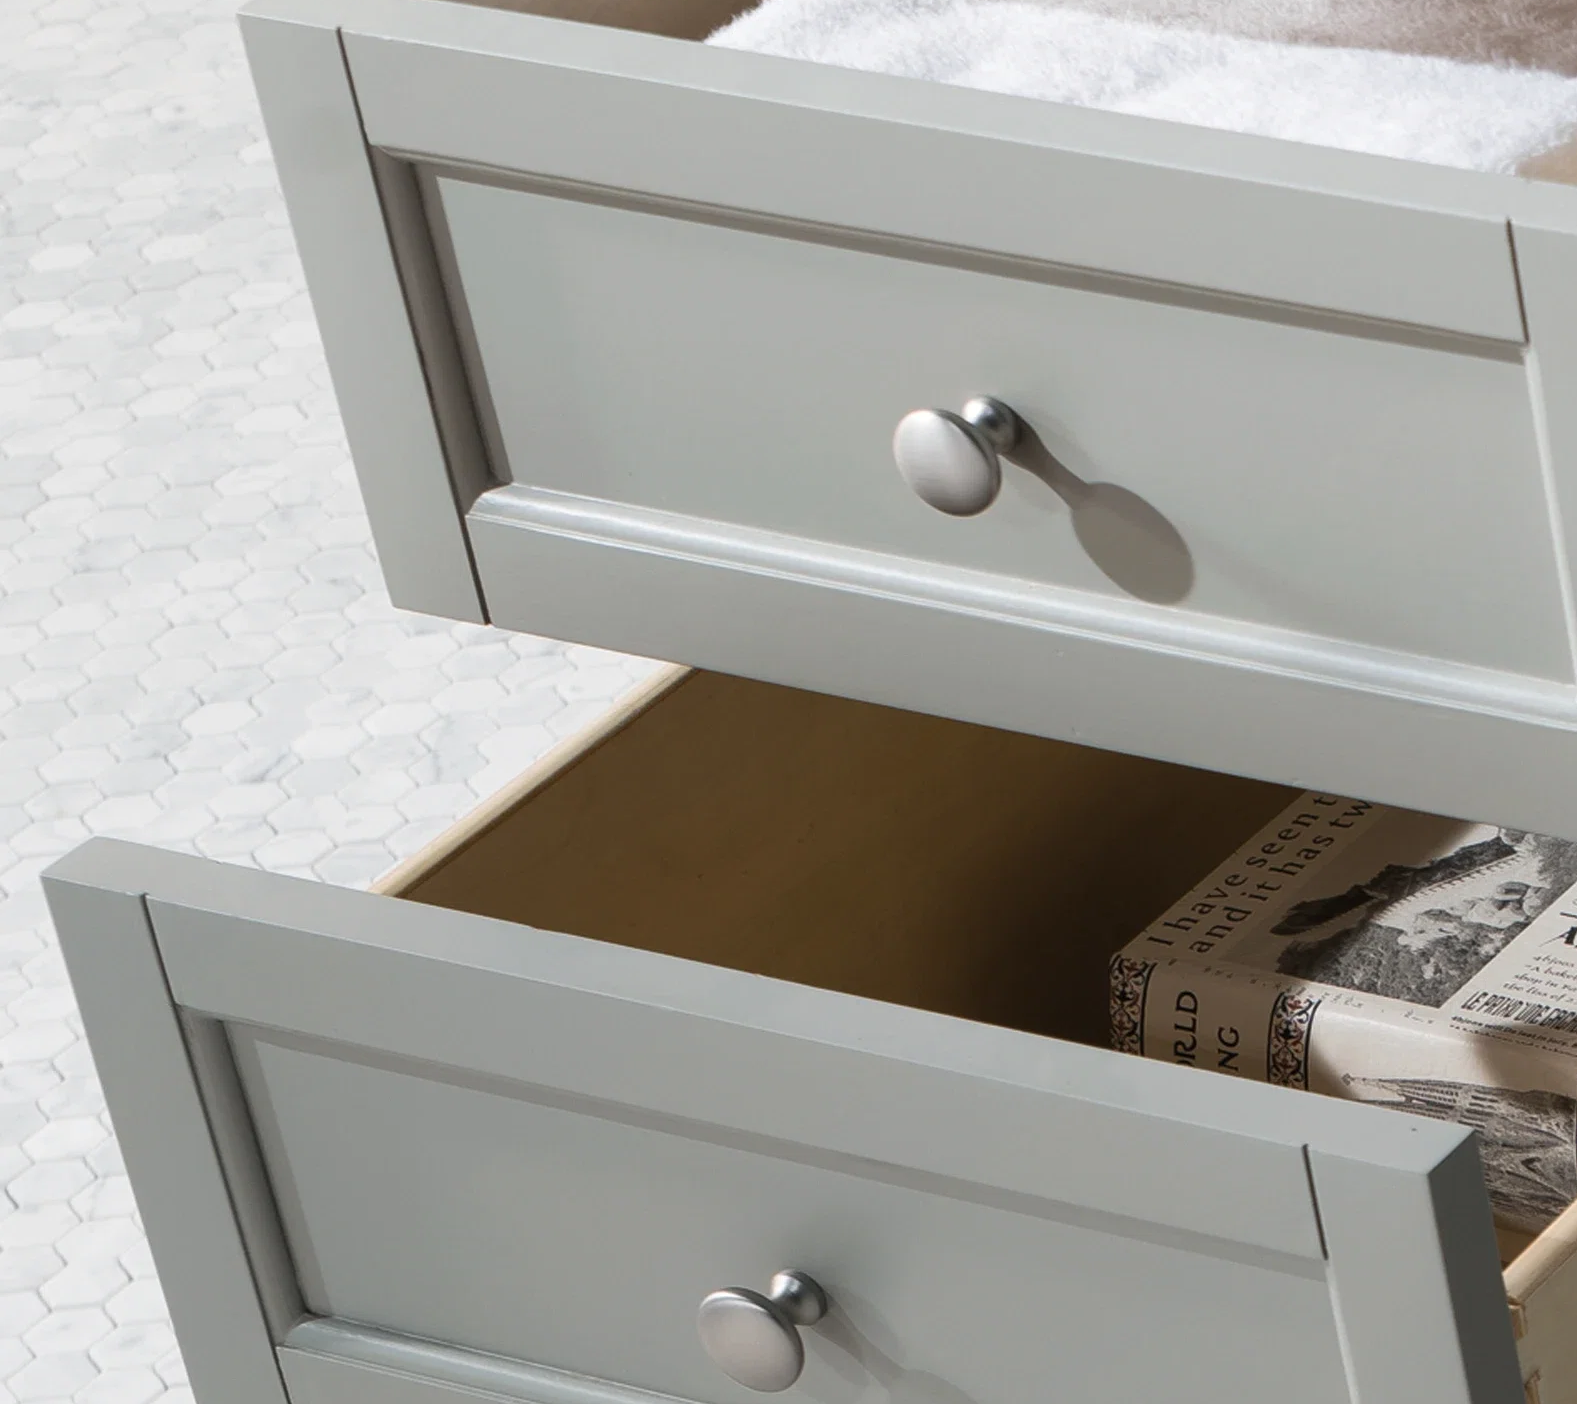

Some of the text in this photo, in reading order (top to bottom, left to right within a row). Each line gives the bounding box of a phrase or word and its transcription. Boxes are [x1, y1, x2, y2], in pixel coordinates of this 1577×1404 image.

[1147, 935, 1175, 947] I
[1164, 872, 1247, 932] have
[1246, 812, 1321, 869] seen
[1188, 902, 1254, 954] and
[1241, 879, 1283, 903] it
[1269, 834, 1335, 878] has
[1217, 1025, 1240, 1072] NG
